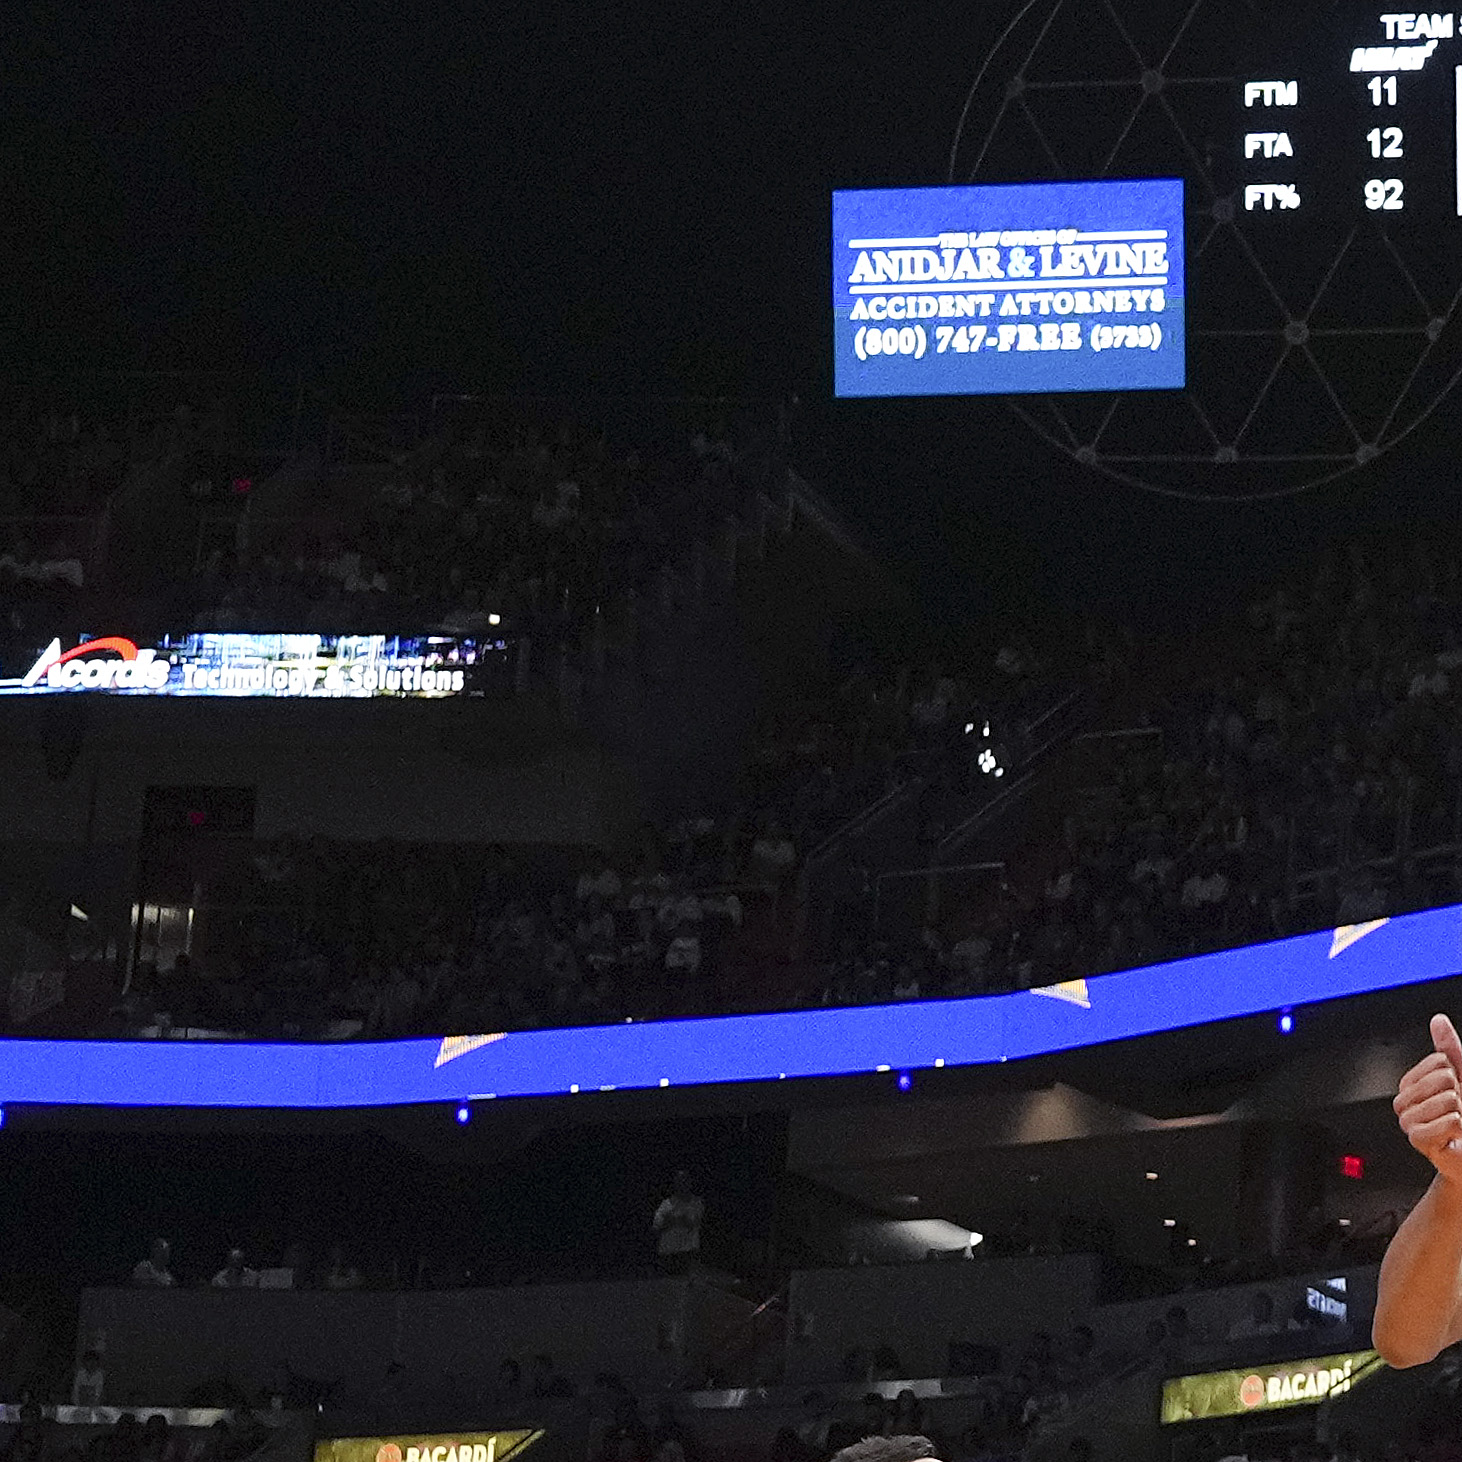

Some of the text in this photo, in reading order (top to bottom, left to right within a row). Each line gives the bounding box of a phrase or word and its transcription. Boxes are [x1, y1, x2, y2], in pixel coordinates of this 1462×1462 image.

[1380, 13, 1454, 40] TEAM
[1245, 80, 1298, 107] FTM
[1367, 76, 1398, 106] 11
[1245, 133, 1293, 158] FTA
[1366, 127, 1404, 158] 12
[1245, 184, 1301, 210] FT%
[1364, 179, 1404, 210] 92
[848, 242, 1169, 283] ANIDJAR & LEVINE
[850, 289, 1166, 320] ACCIDENT ATTORNEYS
[855, 325, 927, 361] (800)
[936, 323, 1082, 353] 747-FREE
[349, 664, 464, 691] Solutions
